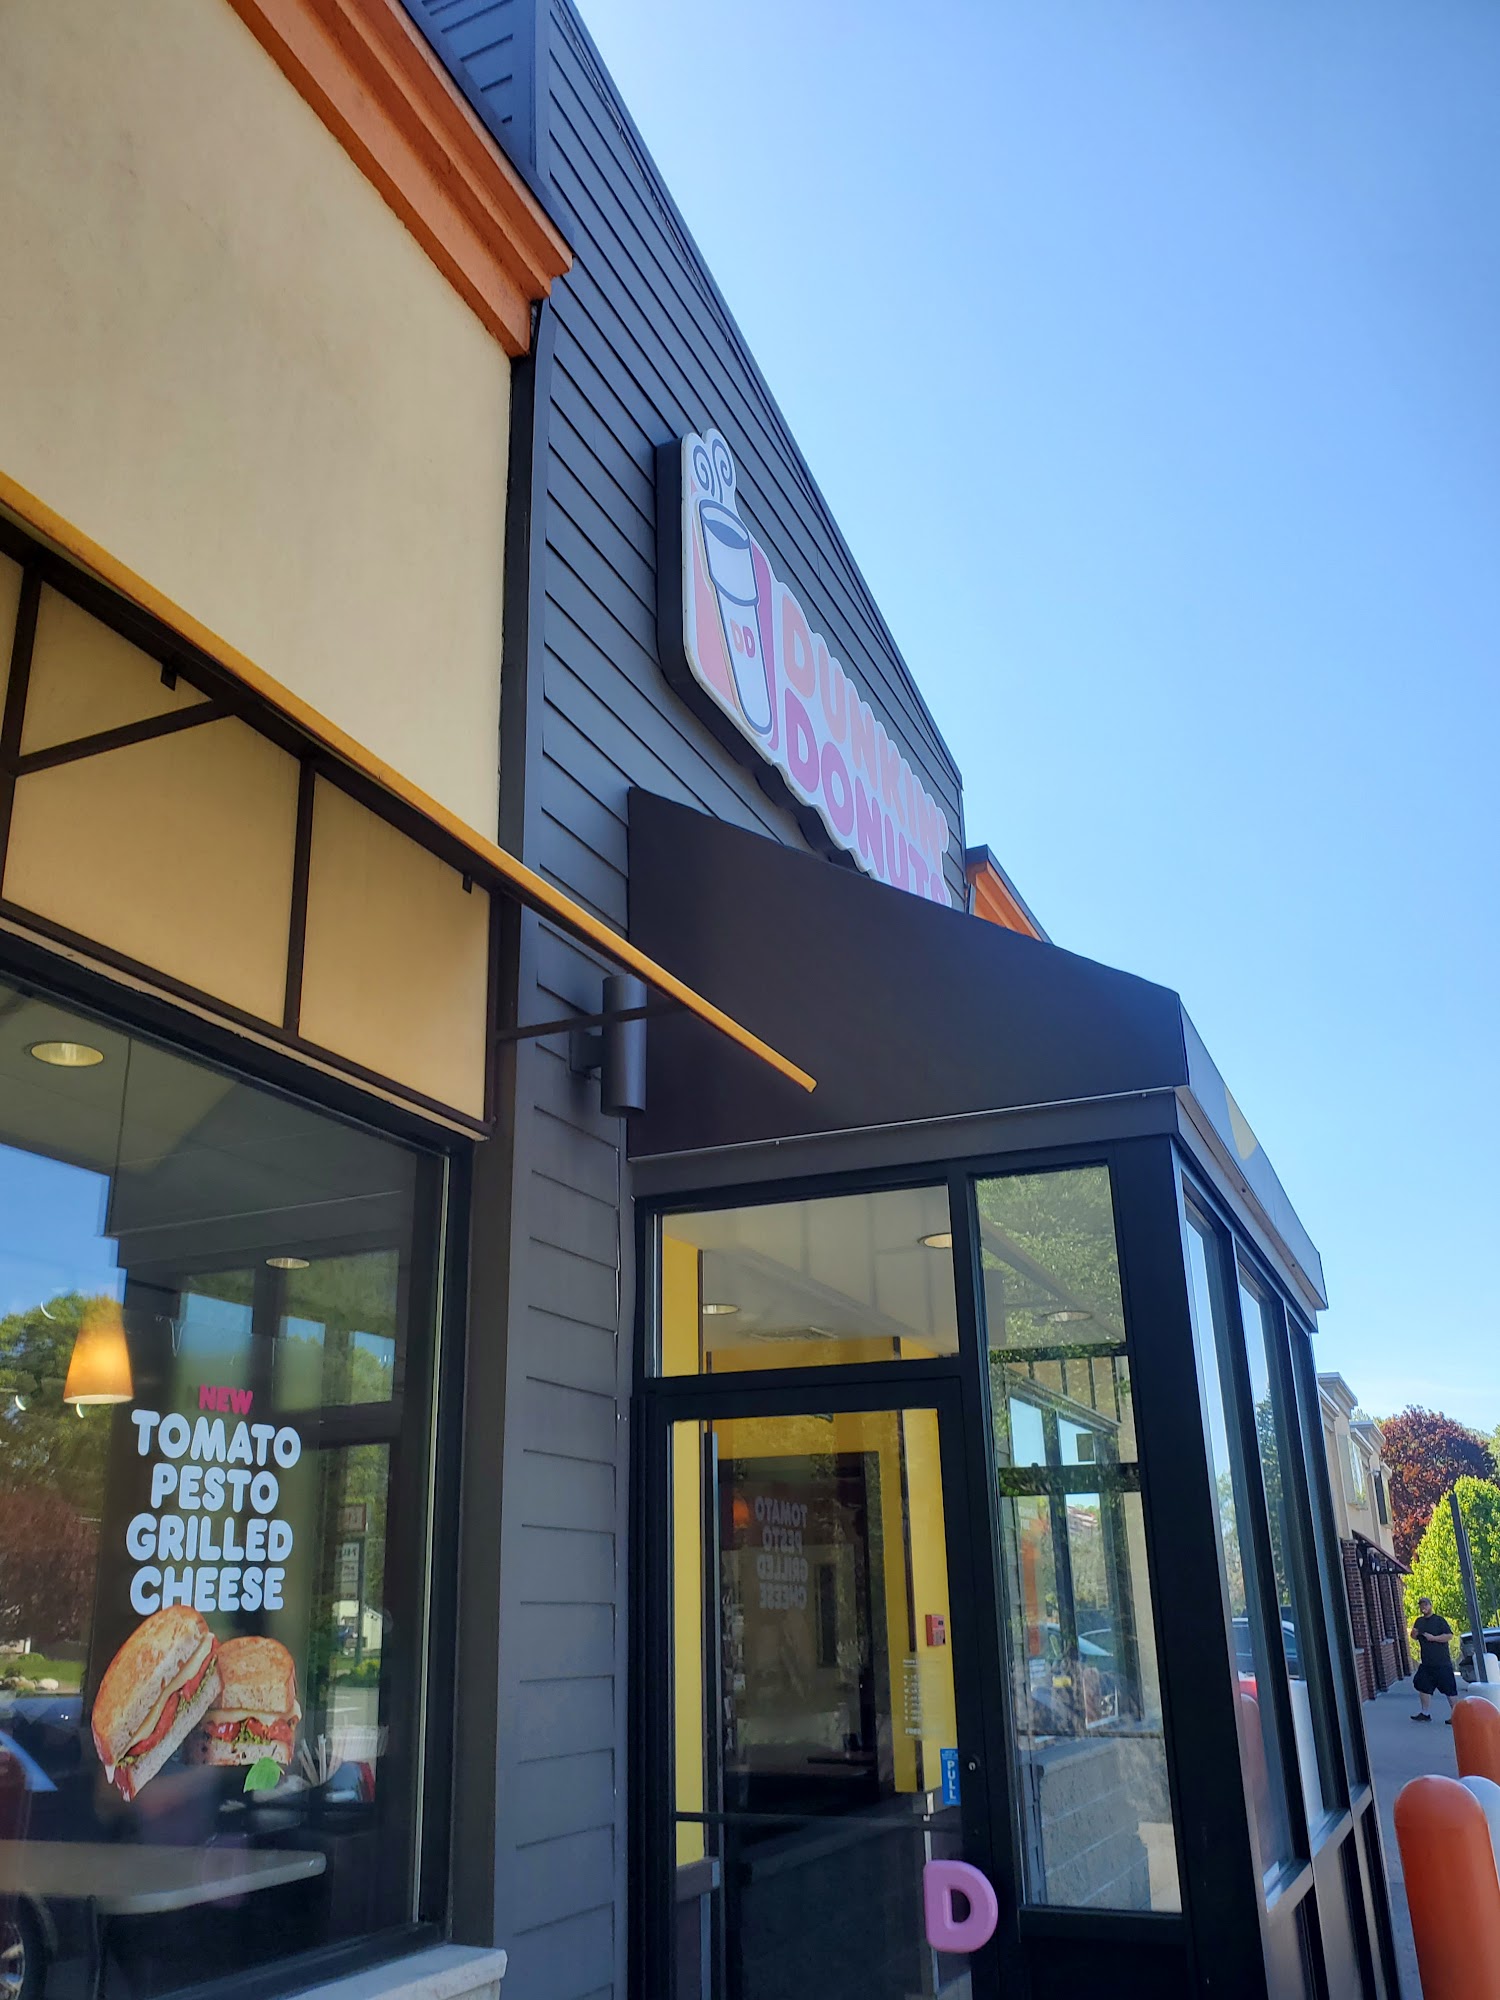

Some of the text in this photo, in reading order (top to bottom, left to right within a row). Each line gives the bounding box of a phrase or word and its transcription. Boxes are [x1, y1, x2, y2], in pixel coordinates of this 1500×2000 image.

[730, 618, 755, 658] DD
[782, 593, 948, 873] DUNKIN'
[199, 1385, 254, 1415] NEW
[131, 1409, 301, 1469] TOMATO
[150, 1462, 279, 1514] PESTO
[126, 1512, 294, 1562] GRILLED
[129, 1565, 286, 1616] CHEESE
[947, 1760, 957, 1800] PULL
[923, 1859, 998, 1953] D
